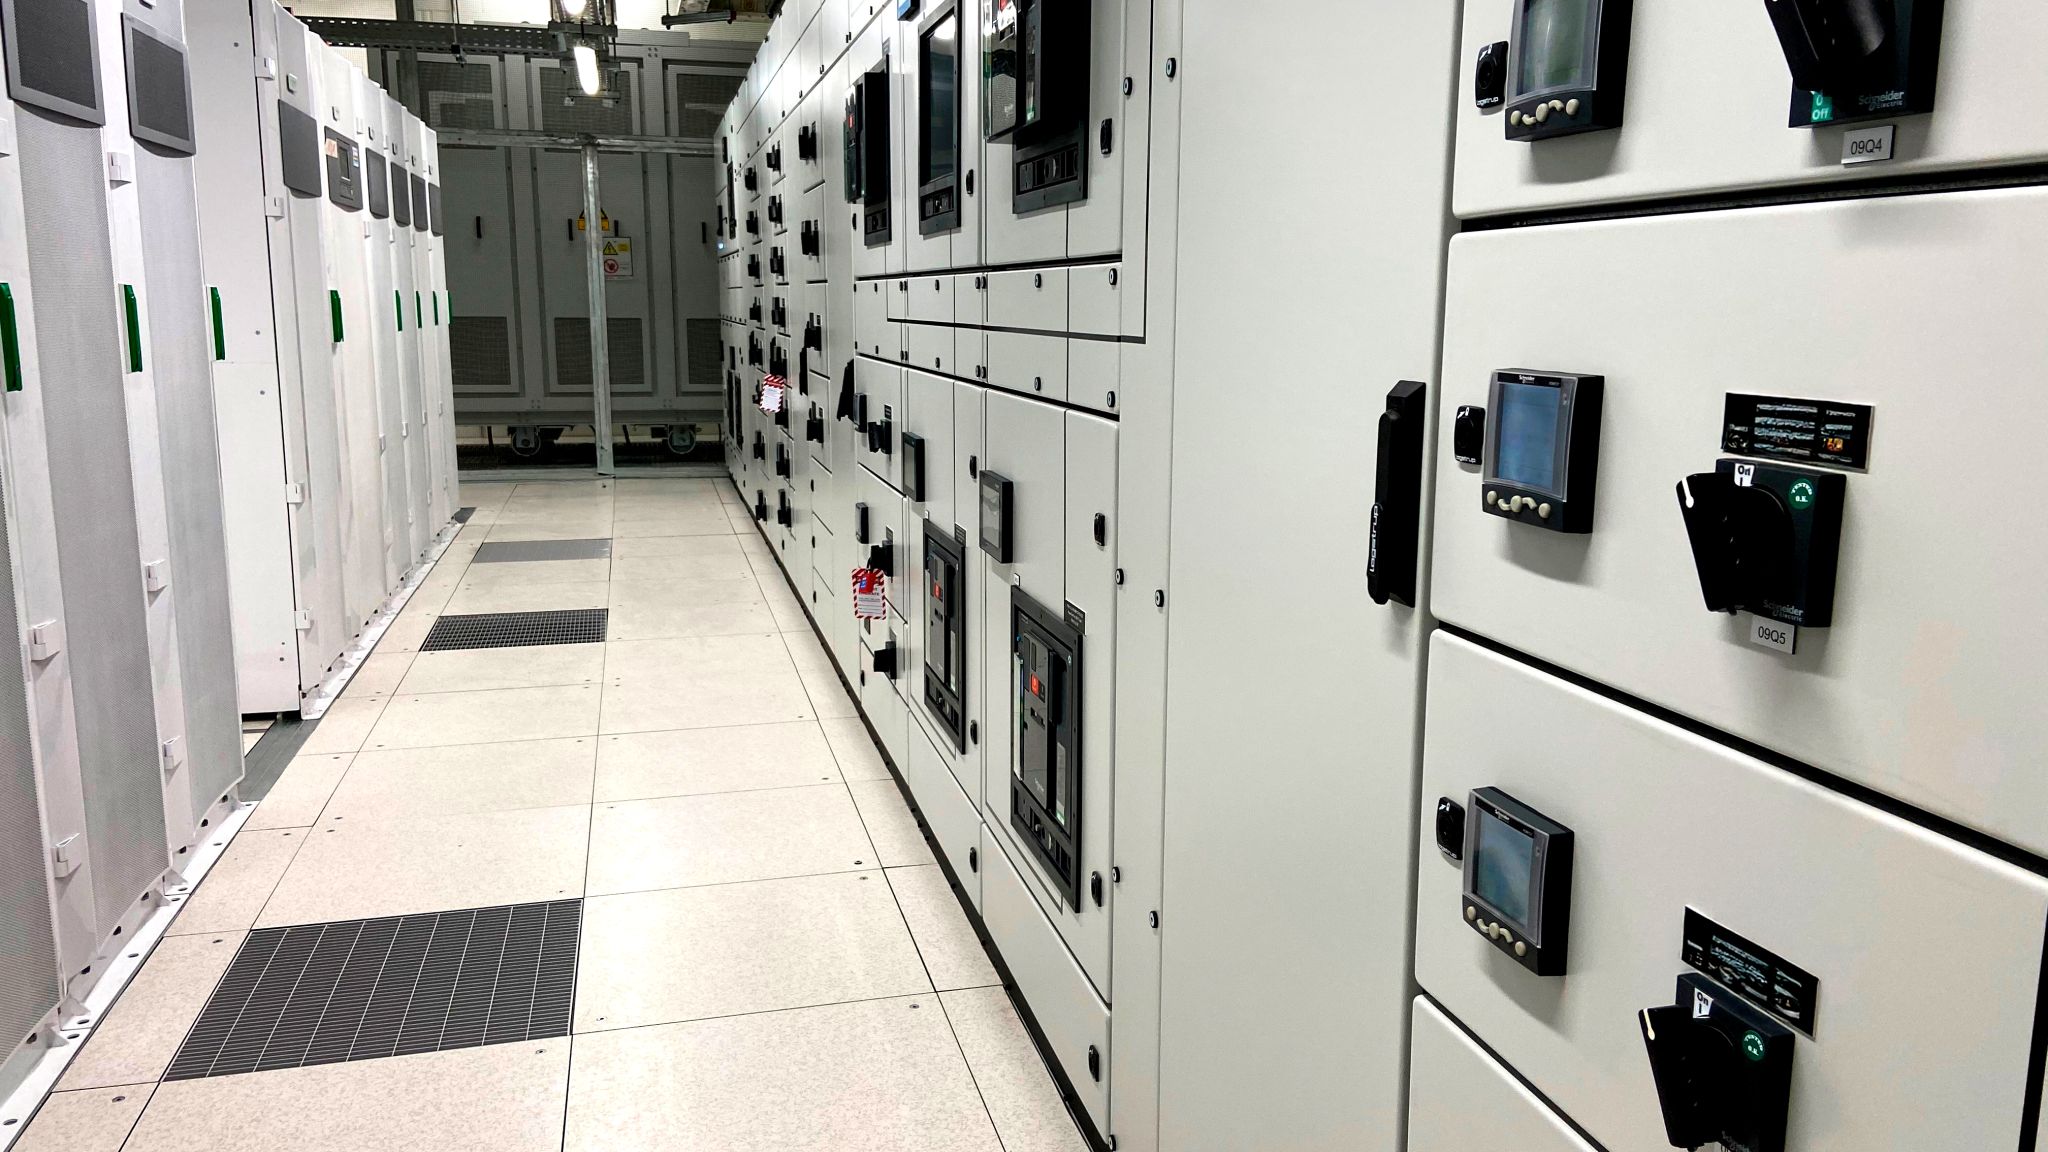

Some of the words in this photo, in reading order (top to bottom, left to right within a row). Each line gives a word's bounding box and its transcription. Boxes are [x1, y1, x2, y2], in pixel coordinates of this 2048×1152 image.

[1812, 107, 1829, 121] Off
[1850, 138, 1883, 155] 09Q4
[1737, 465, 1751, 476] On
[1790, 482, 1813, 495] TESTED
[1758, 626, 1786, 645] 09Q5
[1697, 991, 1709, 1006] On
